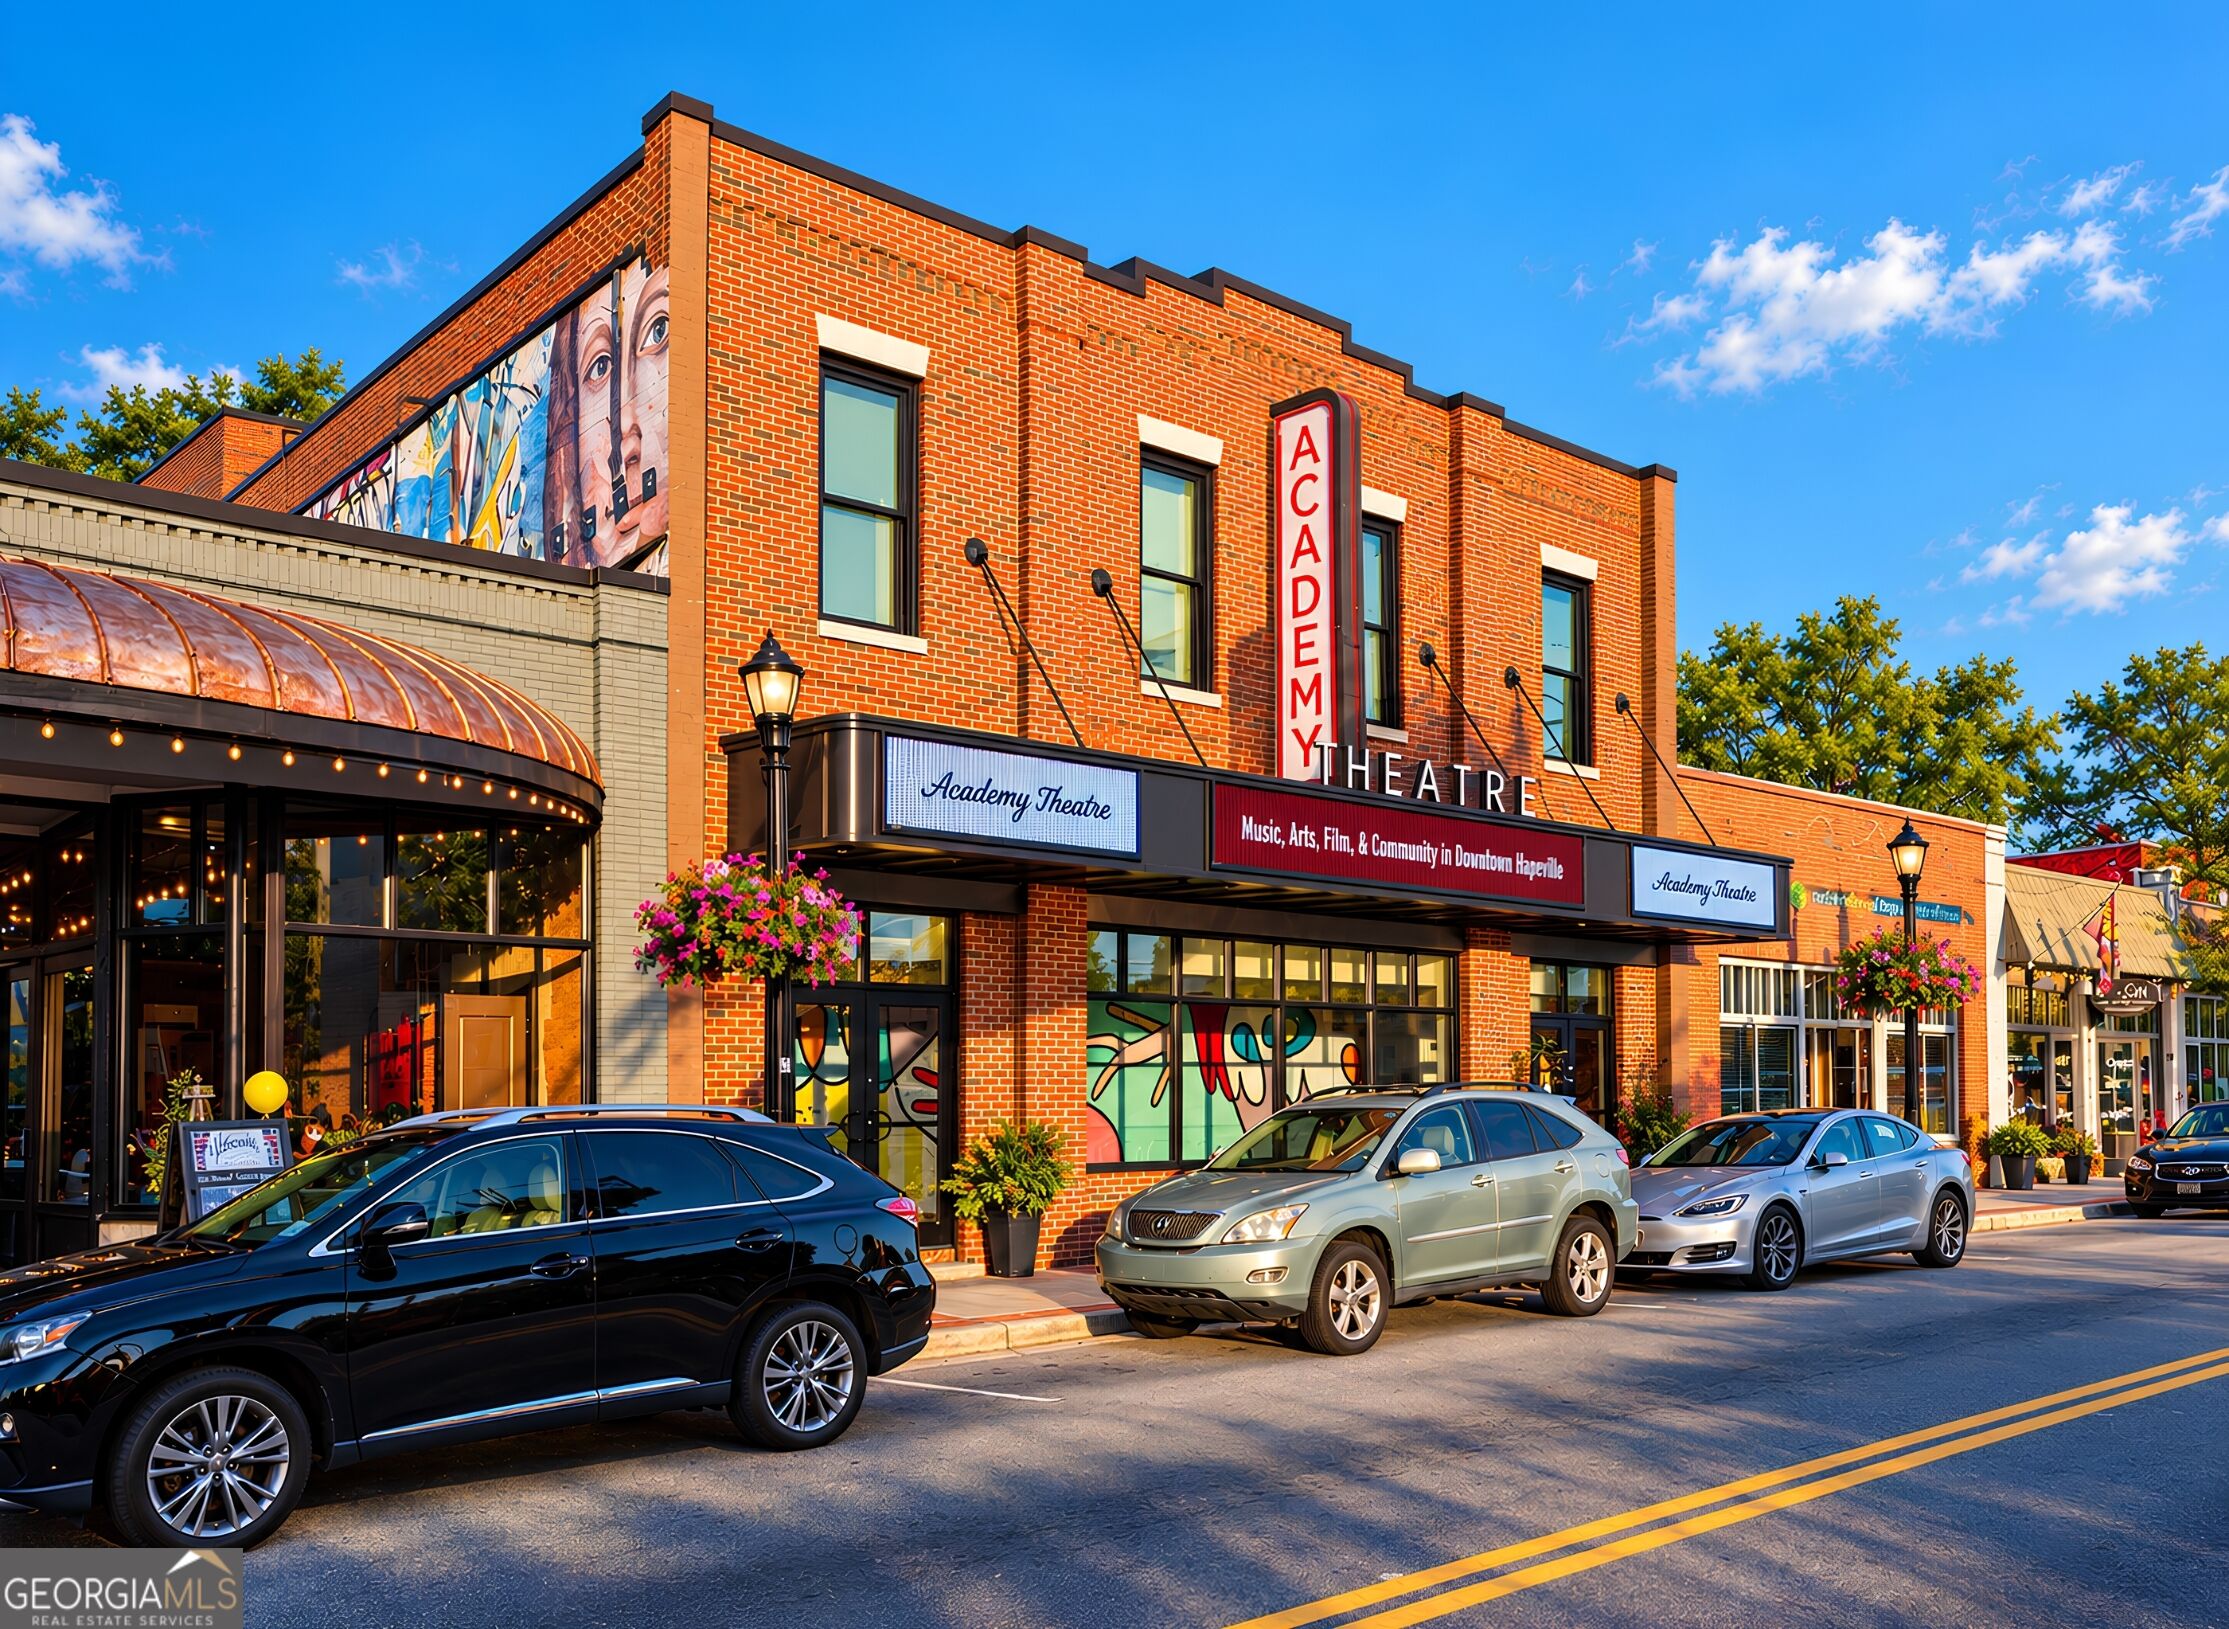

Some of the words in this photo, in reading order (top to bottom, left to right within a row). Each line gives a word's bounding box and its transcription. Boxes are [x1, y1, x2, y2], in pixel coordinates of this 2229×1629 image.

[1289, 425, 1322, 767] ACADEMY
[921, 771, 1032, 823] Academy
[1035, 785, 1112, 820] Theatre
[1314, 742, 1537, 817] THEATRE
[1241, 815, 1285, 849] Music,
[1289, 821, 1320, 852] Arts,
[1324, 826, 1354, 856] Film,
[1358, 831, 1368, 855] &
[1372, 833, 1438, 869] Community
[1441, 842, 1452, 866] in
[1455, 844, 1513, 873] Downtown
[1515, 852, 1564, 881] Hapeville
[1652, 871, 1712, 906] Academy
